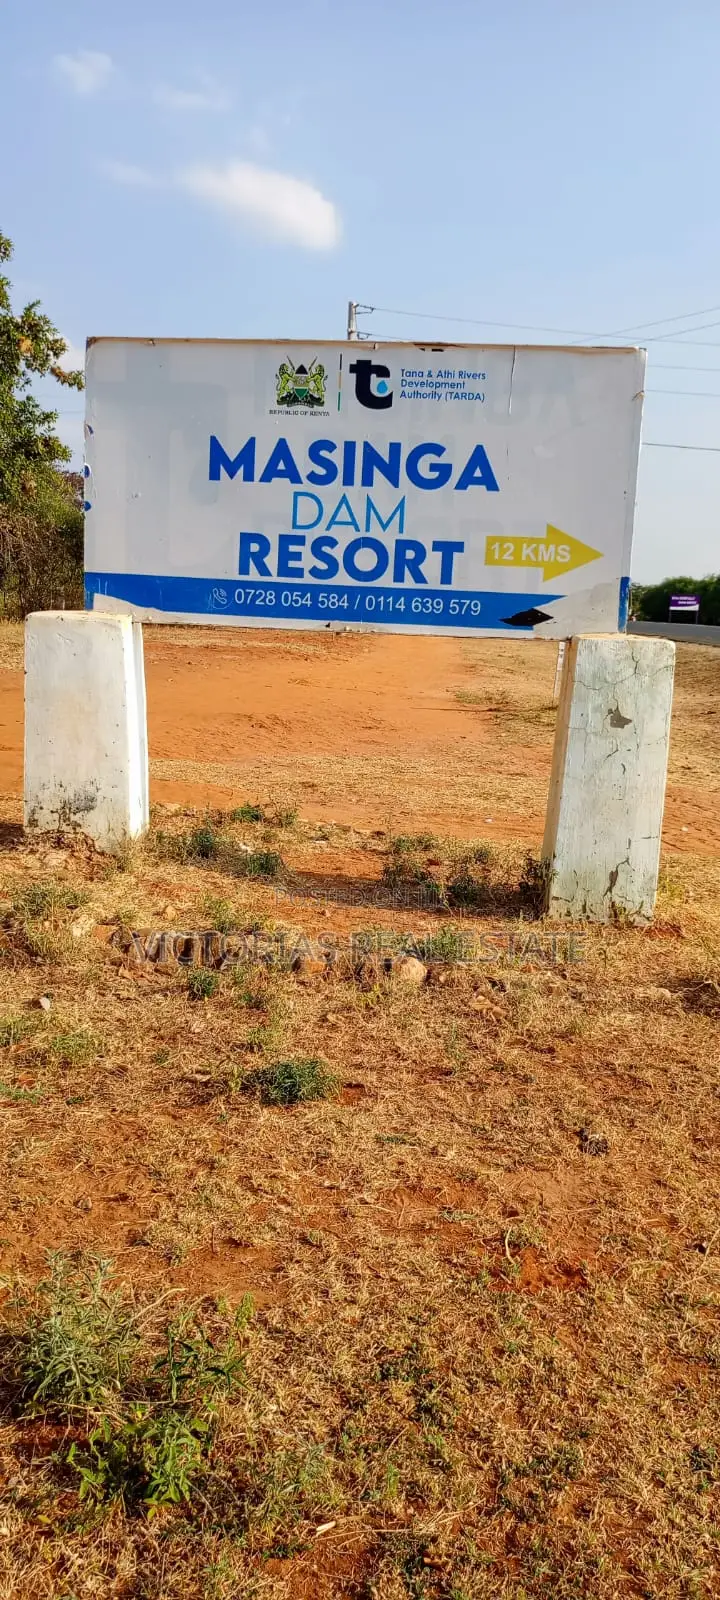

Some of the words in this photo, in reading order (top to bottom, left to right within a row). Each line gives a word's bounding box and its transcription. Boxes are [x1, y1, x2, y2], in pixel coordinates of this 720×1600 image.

[400, 368, 424, 378] Tana
[427, 369, 433, 378] &
[436, 370, 456, 379] Athi
[458, 370, 486, 380] Rivers
[400, 379, 466, 390] Development
[400, 390, 442, 402] Authority
[445, 391, 486, 403] (TARDA)
[208, 435, 500, 492] MASINGA
[291, 491, 407, 534] DAM
[237, 532, 465, 586] RESORT
[491, 542, 515, 561] 12
[521, 543, 571, 563] KMS
[234, 588, 276, 606] 0728
[281, 591, 313, 608] 054
[317, 593, 349, 609] 584
[353, 594, 361, 610] /
[365, 595, 406, 613] 0114
[411, 597, 444, 614] 639
[448, 599, 482, 616] 579
